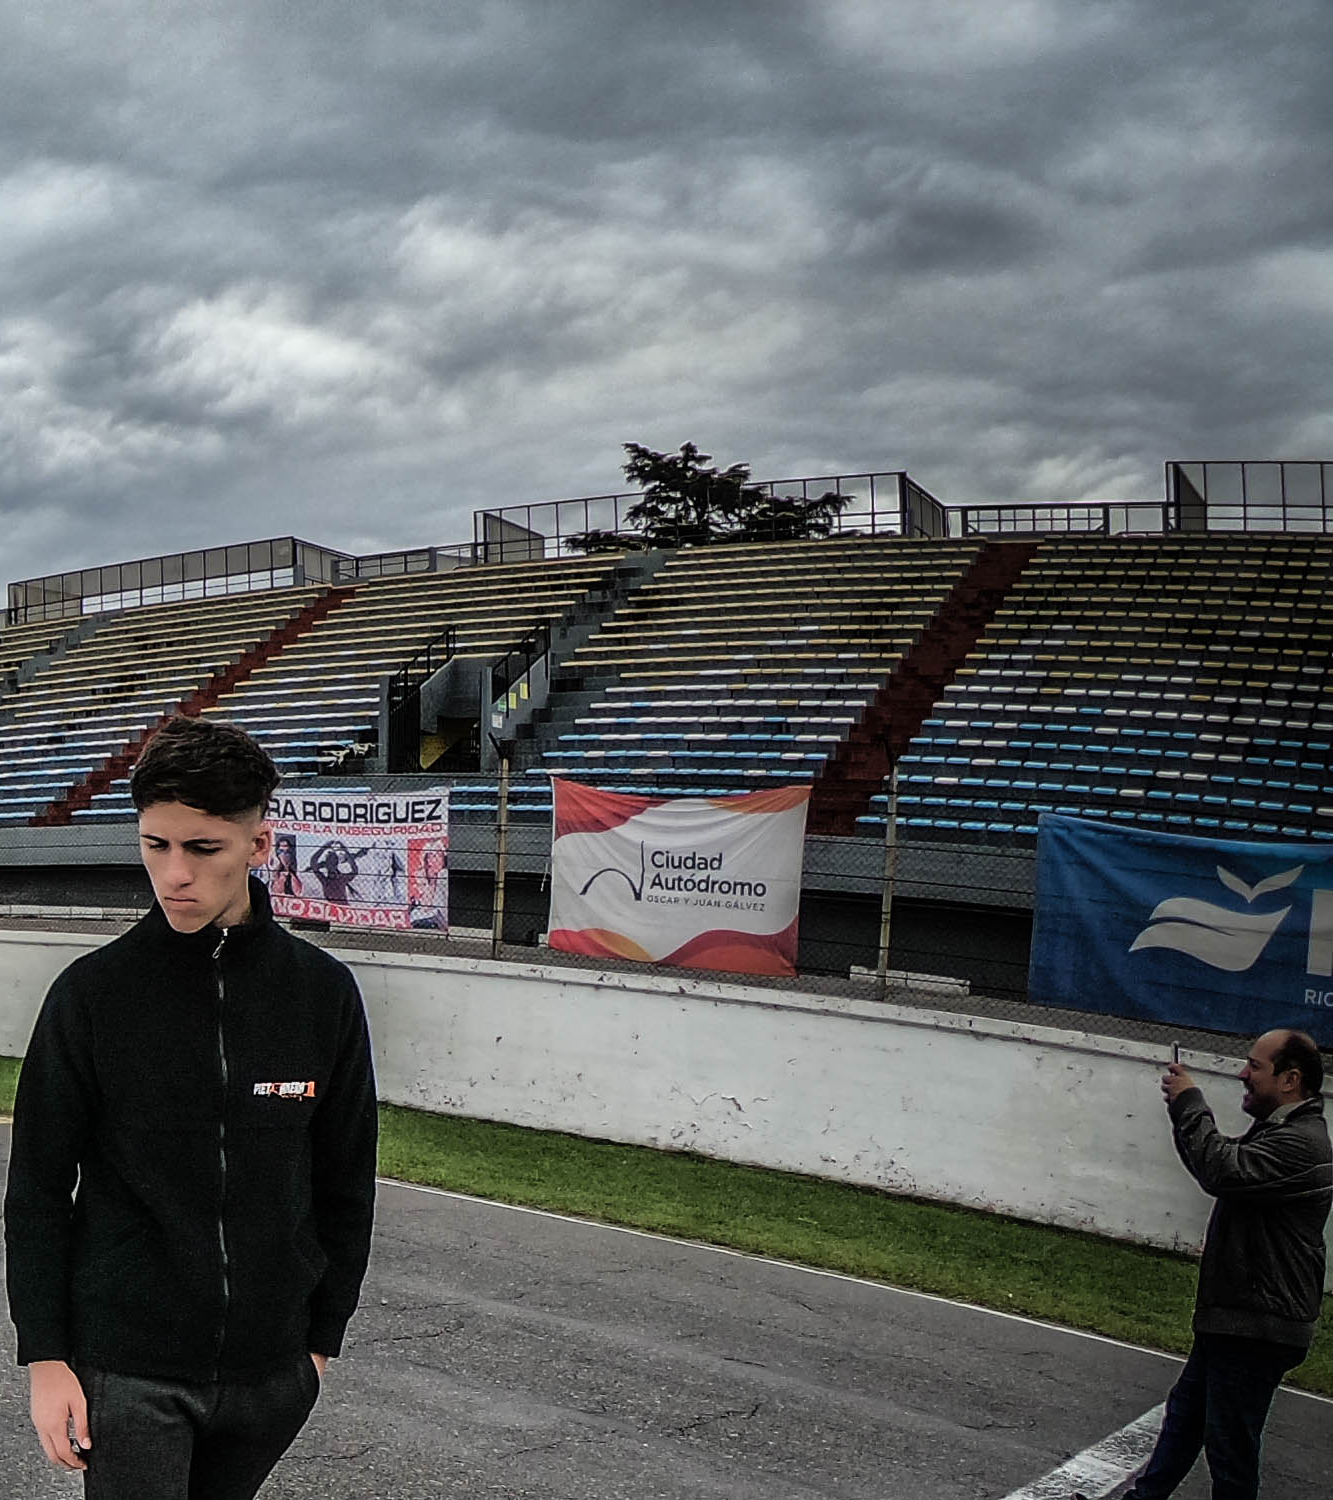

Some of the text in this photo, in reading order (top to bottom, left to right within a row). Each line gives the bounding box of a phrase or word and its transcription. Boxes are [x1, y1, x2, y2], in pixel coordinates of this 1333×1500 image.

[313, 825, 333, 836] LA
[335, 823, 443, 836] INSEGURIDAD
[650, 850, 723, 870] Ciudad
[649, 872, 767, 898] Autódromo
[646, 895, 766, 912] OSCAR Y JUAN GÁLVEZ
